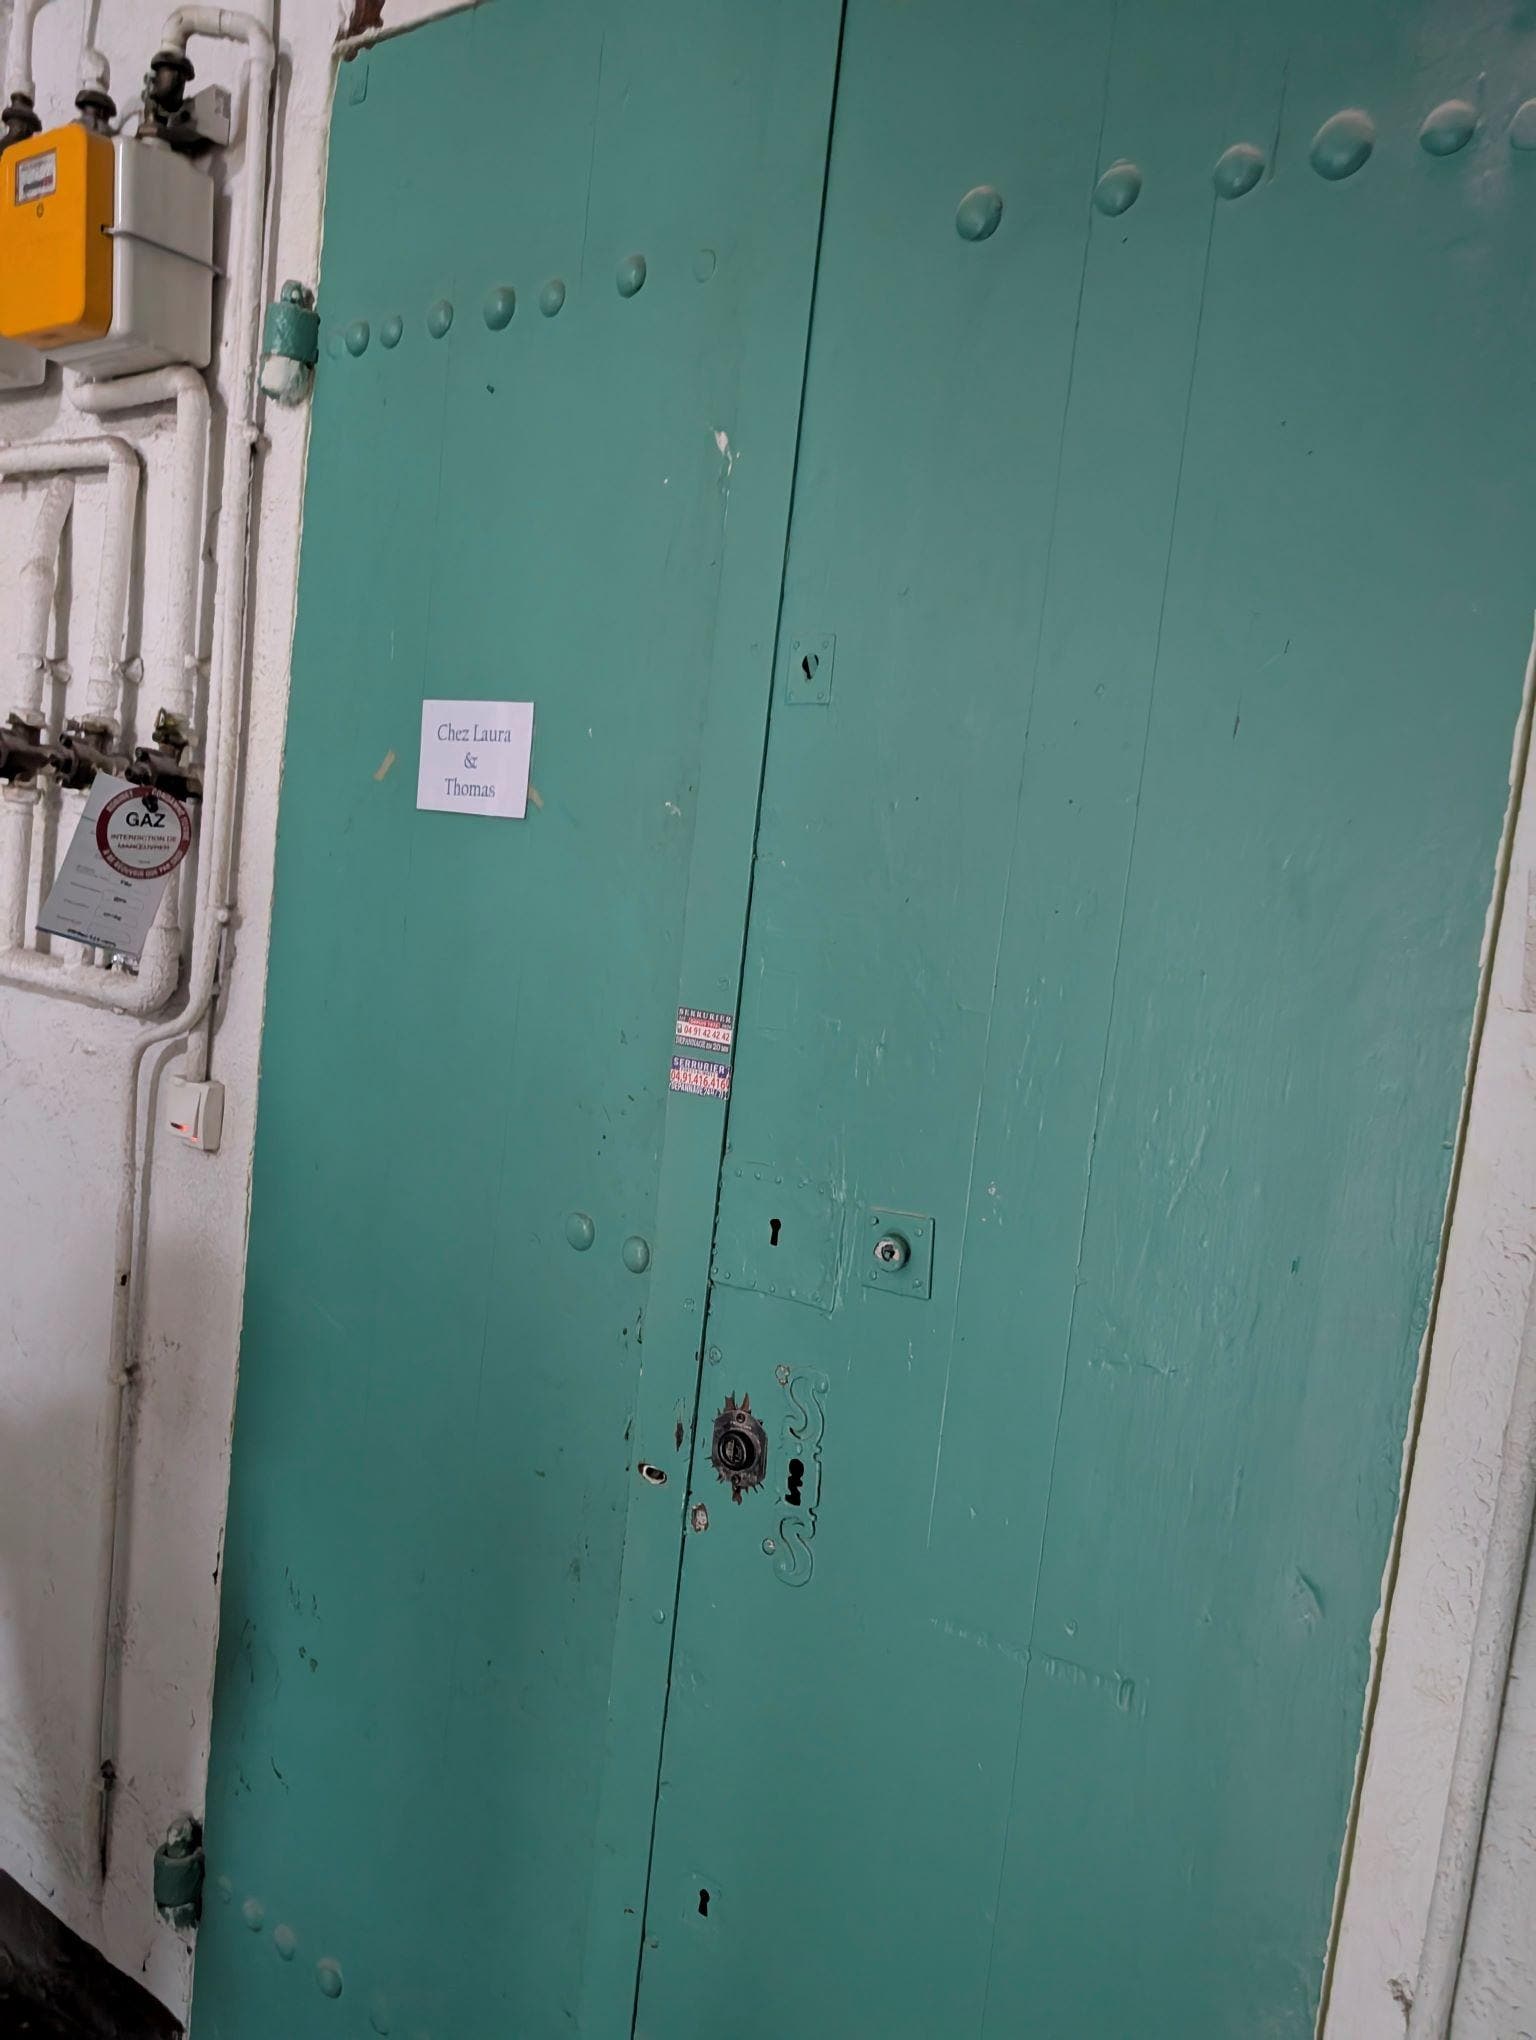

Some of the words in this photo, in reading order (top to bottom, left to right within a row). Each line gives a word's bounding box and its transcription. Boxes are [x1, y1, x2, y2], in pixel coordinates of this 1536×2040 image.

[437, 723, 469, 742] Chez
[473, 724, 511, 743] Laura
[464, 752, 478, 769] &
[445, 777, 496, 798] Thomas
[125, 811, 166, 828] GAZ
[684, 1025, 692, 1034] 04
[694, 1026, 701, 1036] 91
[703, 1028, 711, 1038] 42
[712, 1030, 720, 1040] 42
[722, 1032, 730, 1042] 42
[713, 1043, 721, 1051] 20
[673, 1056, 725, 1074] SERRURIER
